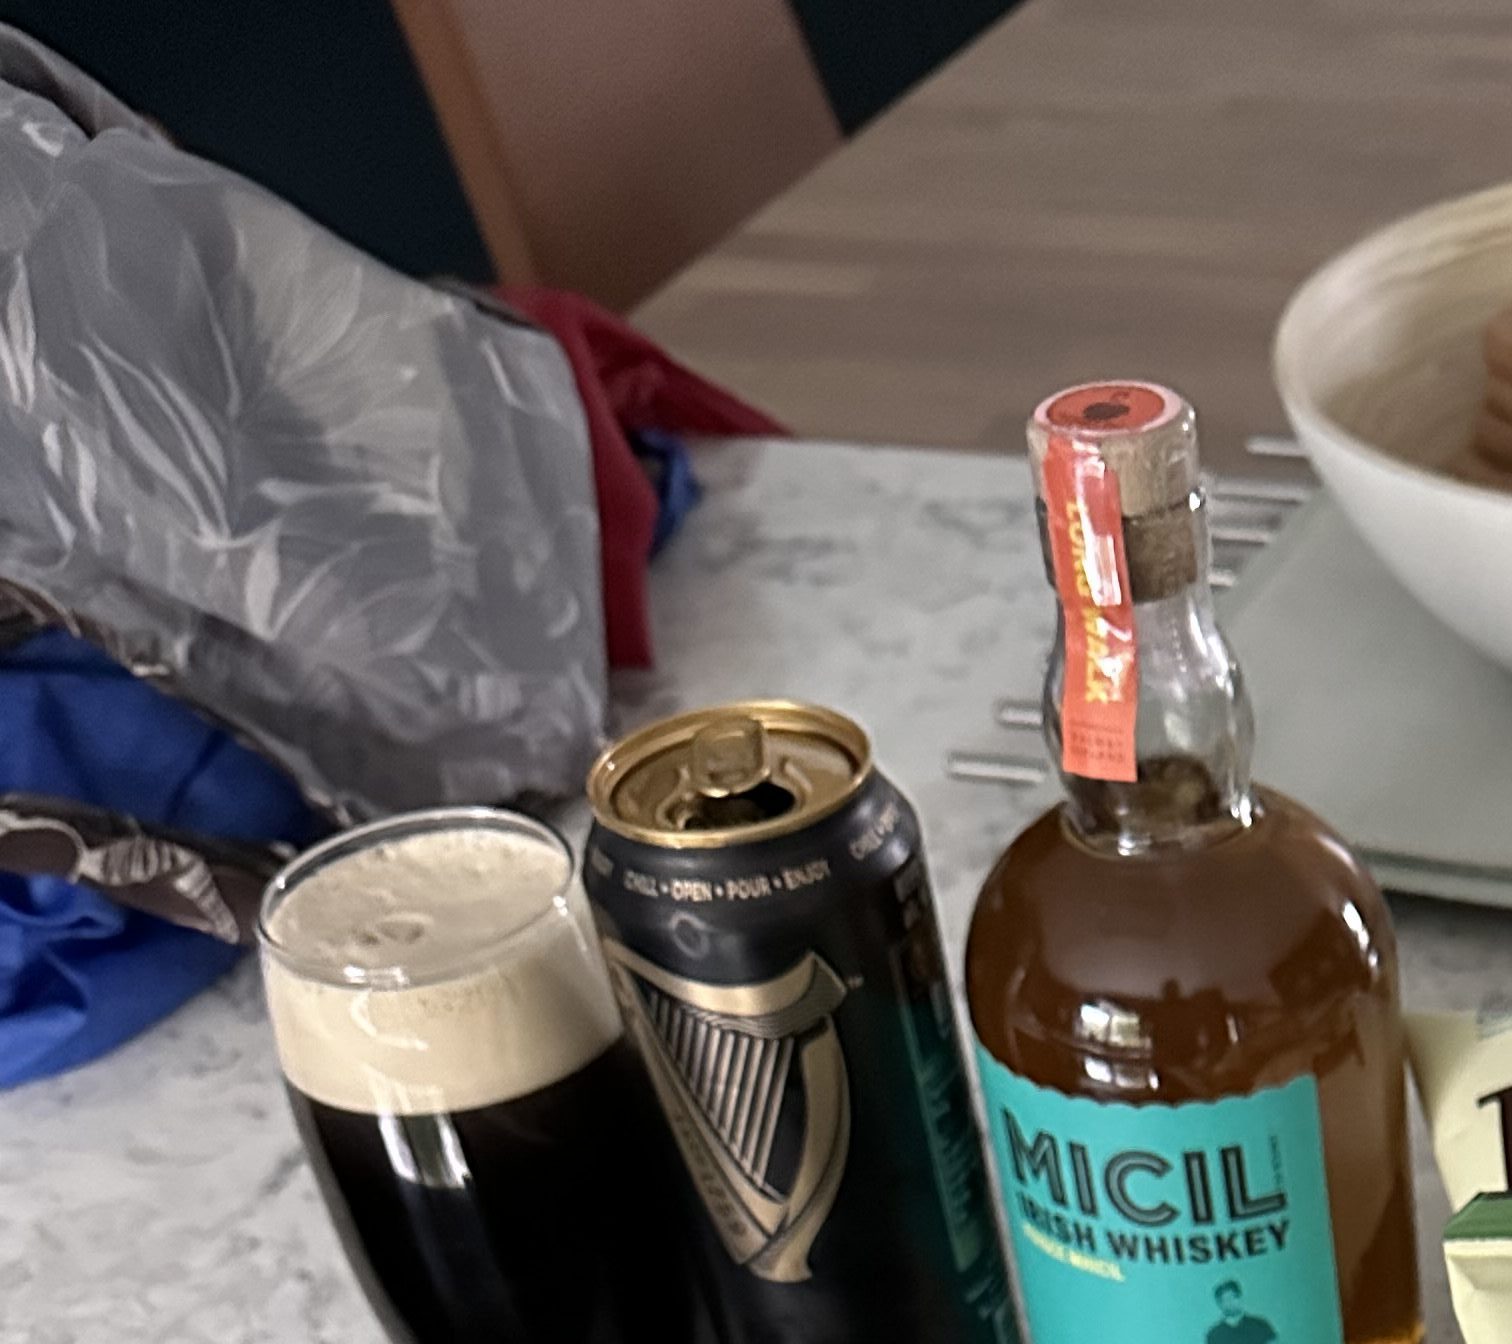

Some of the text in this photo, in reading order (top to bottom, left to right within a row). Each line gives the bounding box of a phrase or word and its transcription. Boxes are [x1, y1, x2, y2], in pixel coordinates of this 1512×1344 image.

[671, 878, 712, 902] OPEN
[725, 875, 772, 901] POUR
[1003, 1106, 1287, 1227] MICIL
[1105, 1220, 1290, 1265] WHISKEY
